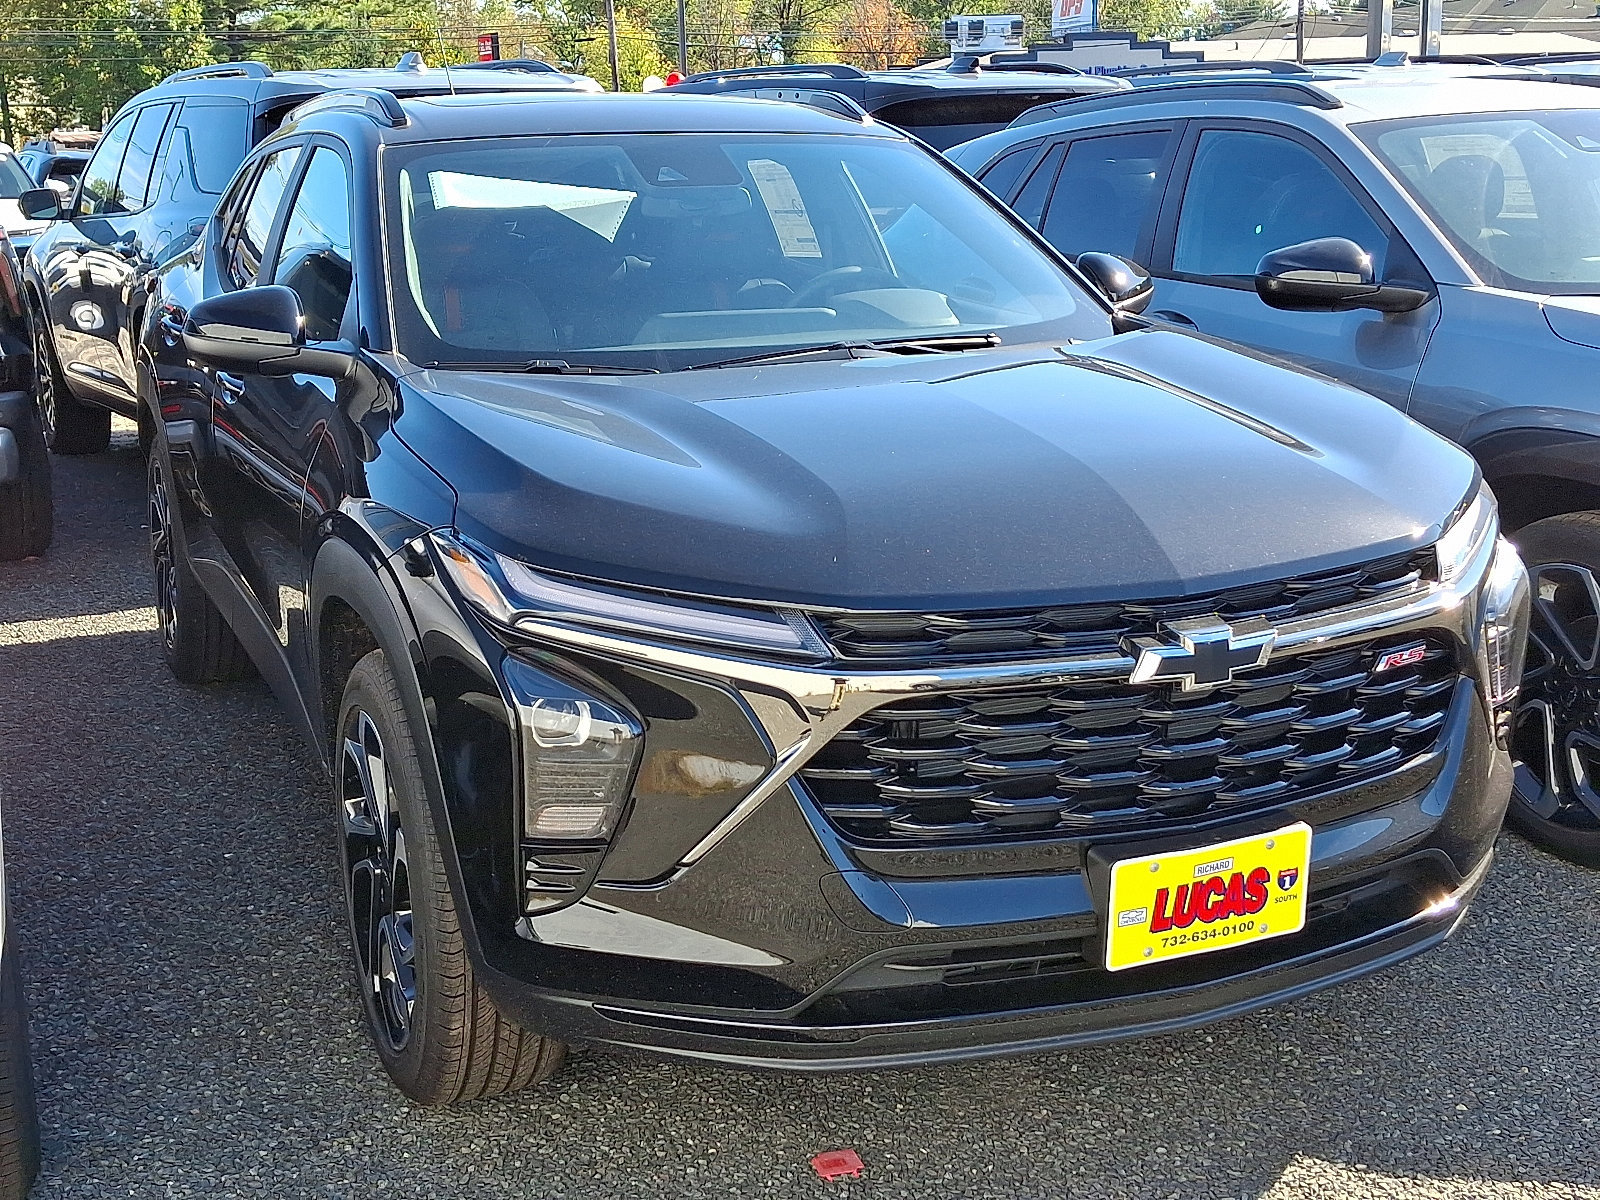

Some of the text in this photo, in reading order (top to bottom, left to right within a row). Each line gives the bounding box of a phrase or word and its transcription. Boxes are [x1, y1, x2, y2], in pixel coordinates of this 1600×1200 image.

[1377, 644, 1426, 671] RS
[1197, 860, 1230, 875] RICHARD
[1282, 876, 1291, 889] 1
[1149, 866, 1271, 933] LUCAS
[1274, 893, 1298, 904] SOUTH
[1161, 920, 1255, 948] 732-634-0100
